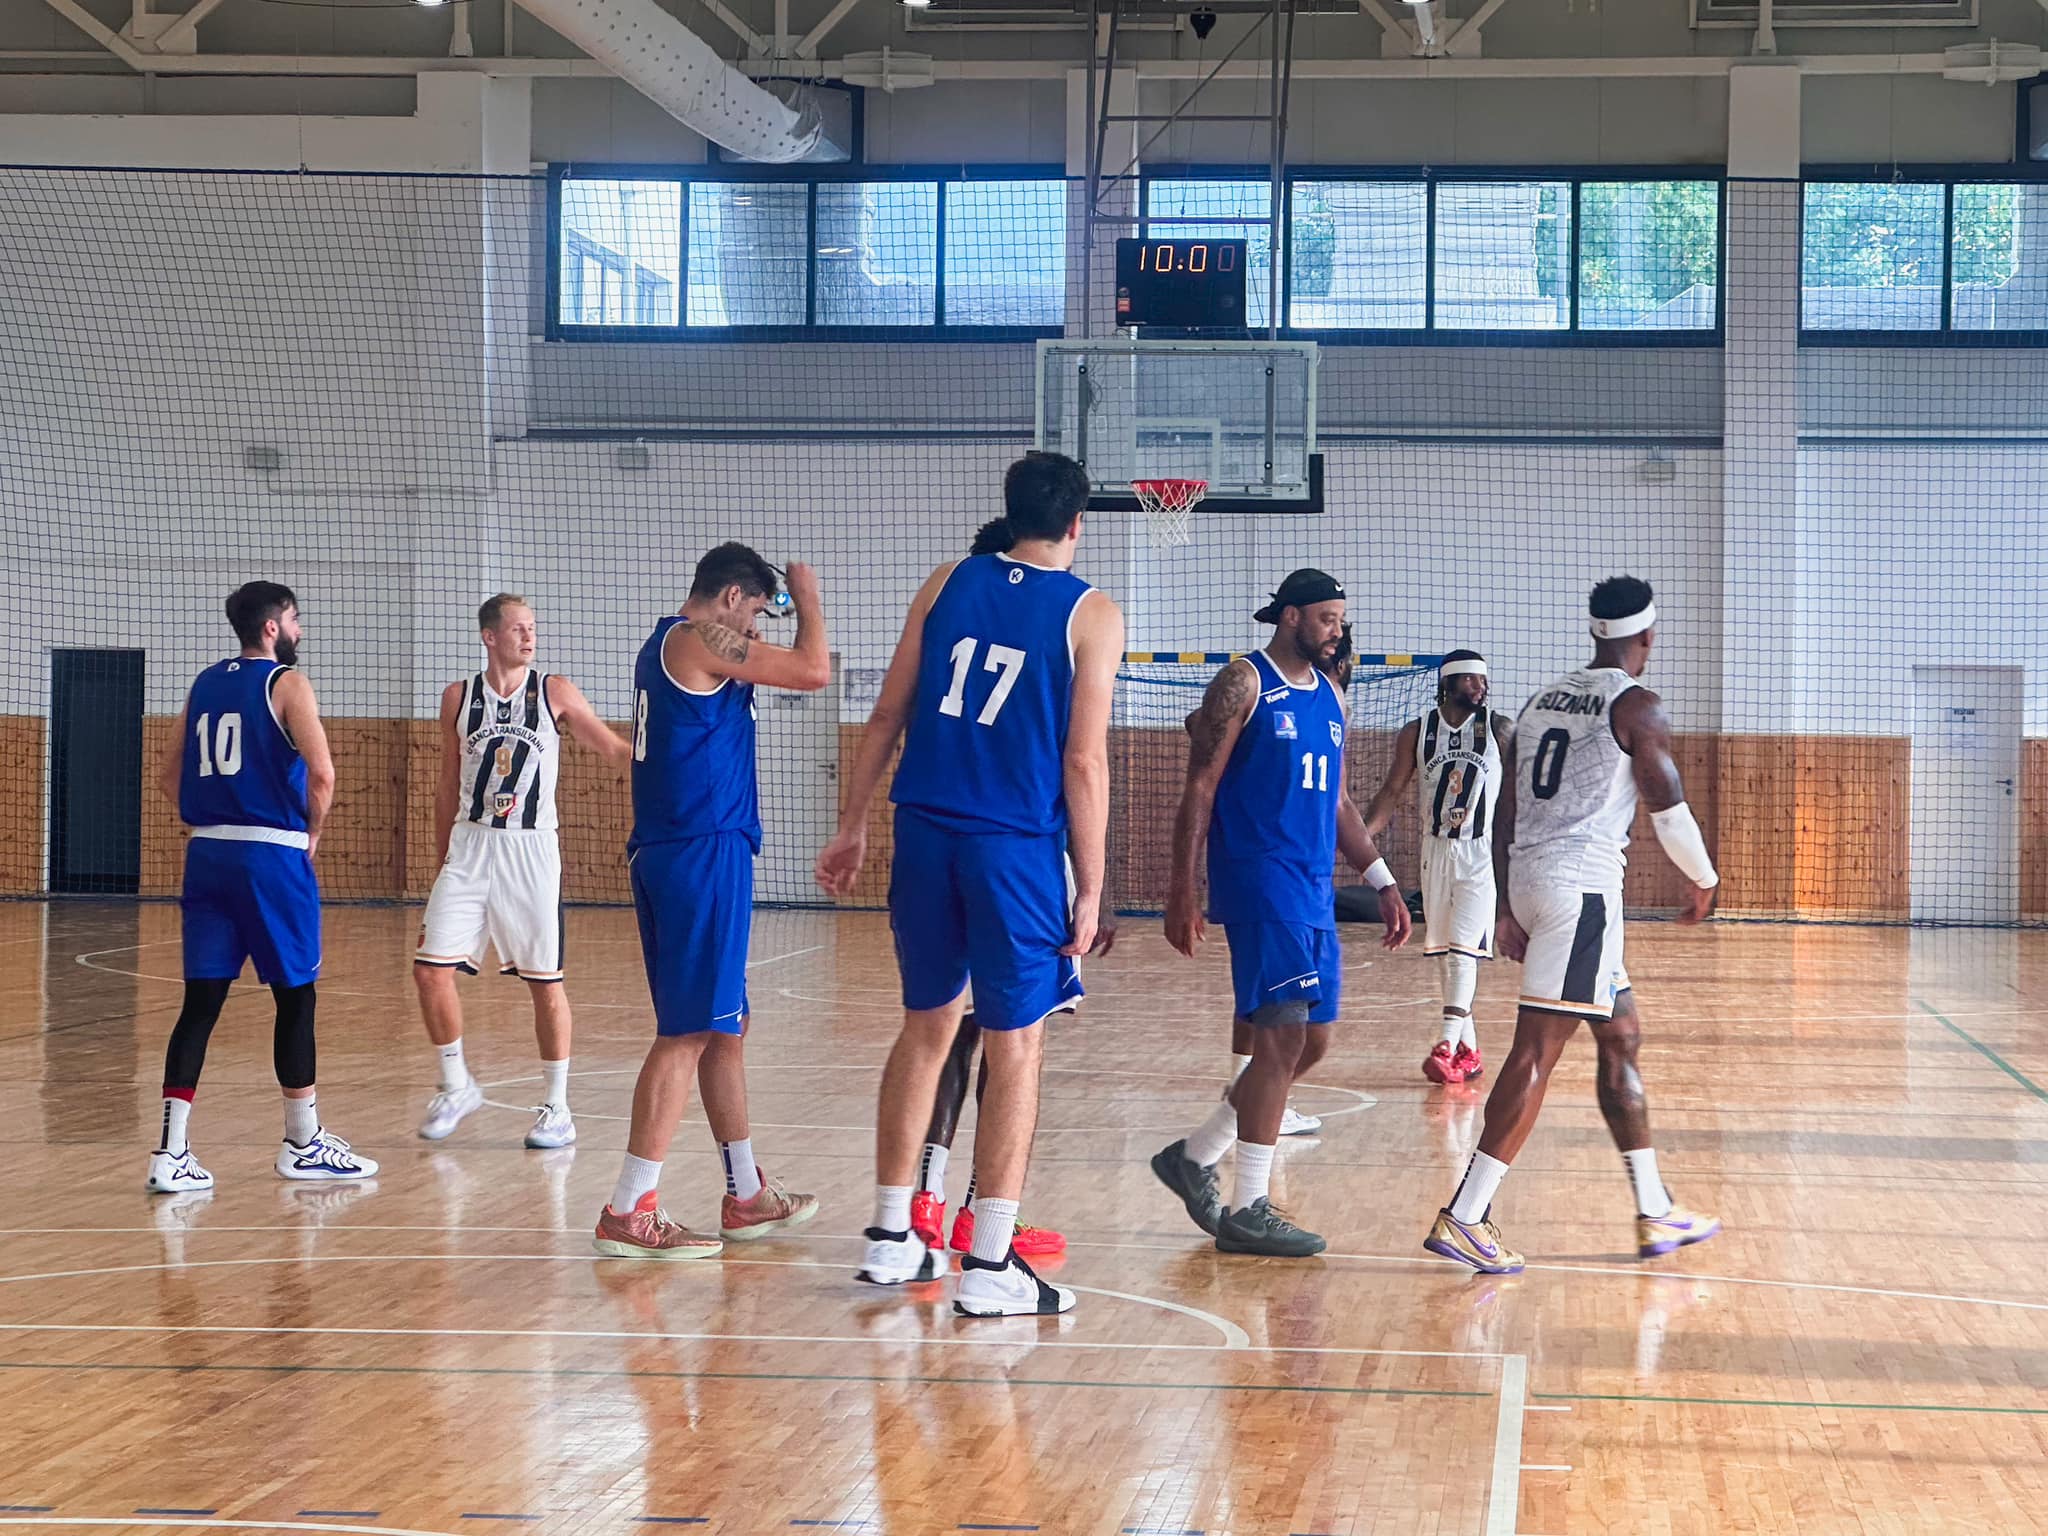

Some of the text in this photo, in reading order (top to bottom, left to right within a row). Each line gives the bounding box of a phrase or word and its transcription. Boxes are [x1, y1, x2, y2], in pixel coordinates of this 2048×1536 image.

[938, 636, 1027, 727] 17
[196, 712, 242, 777] 10
[495, 746, 512, 777] 9
[1302, 752, 1328, 792] 11
[1532, 727, 1570, 800] 0
[1449, 769, 1463, 794] 3
[497, 798, 512, 807] BT
[1451, 812, 1464, 820] BT
